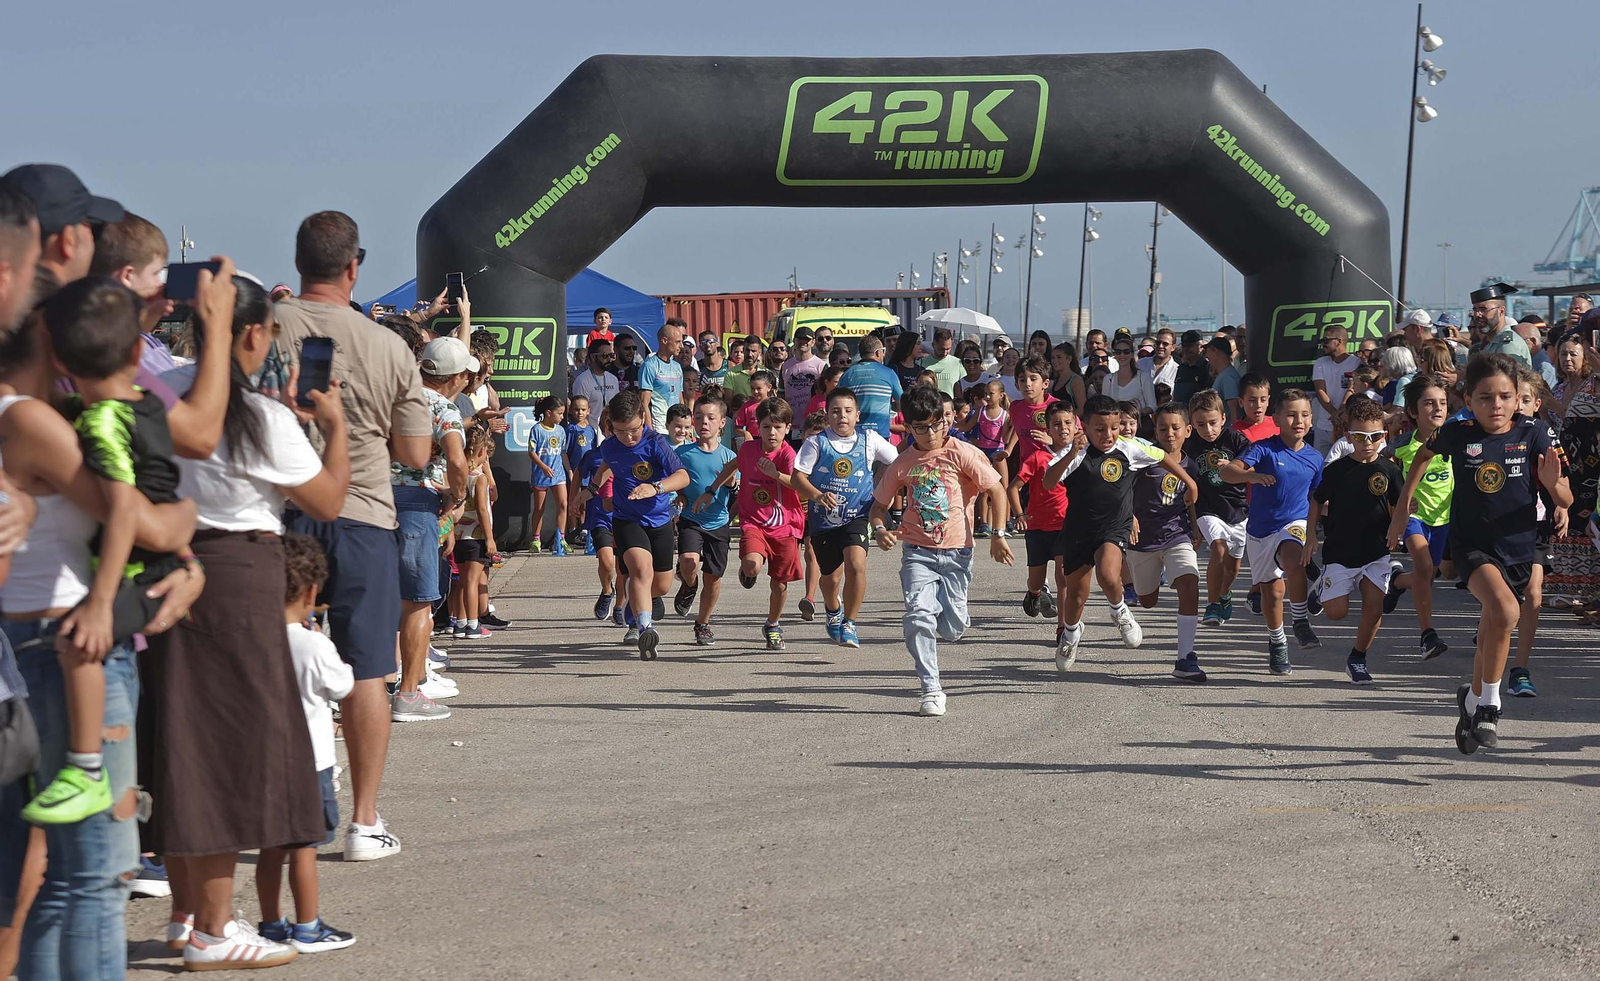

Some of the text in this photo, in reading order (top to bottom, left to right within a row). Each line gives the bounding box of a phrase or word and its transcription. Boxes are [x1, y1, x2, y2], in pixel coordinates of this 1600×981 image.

[812, 89, 1014, 144] 42K
[874, 143, 1005, 175] TM running
[495, 132, 622, 249] 42krunning.com
[1206, 124, 1331, 236] 42krunning.com
[1283, 310, 1384, 341] 42K
[486, 326, 545, 356] 2K
[496, 389, 551, 400] nning.com
[1277, 376, 1312, 384] www.
[820, 483, 843, 492] GUARDIA
[1477, 721, 1496, 731] PUMA
